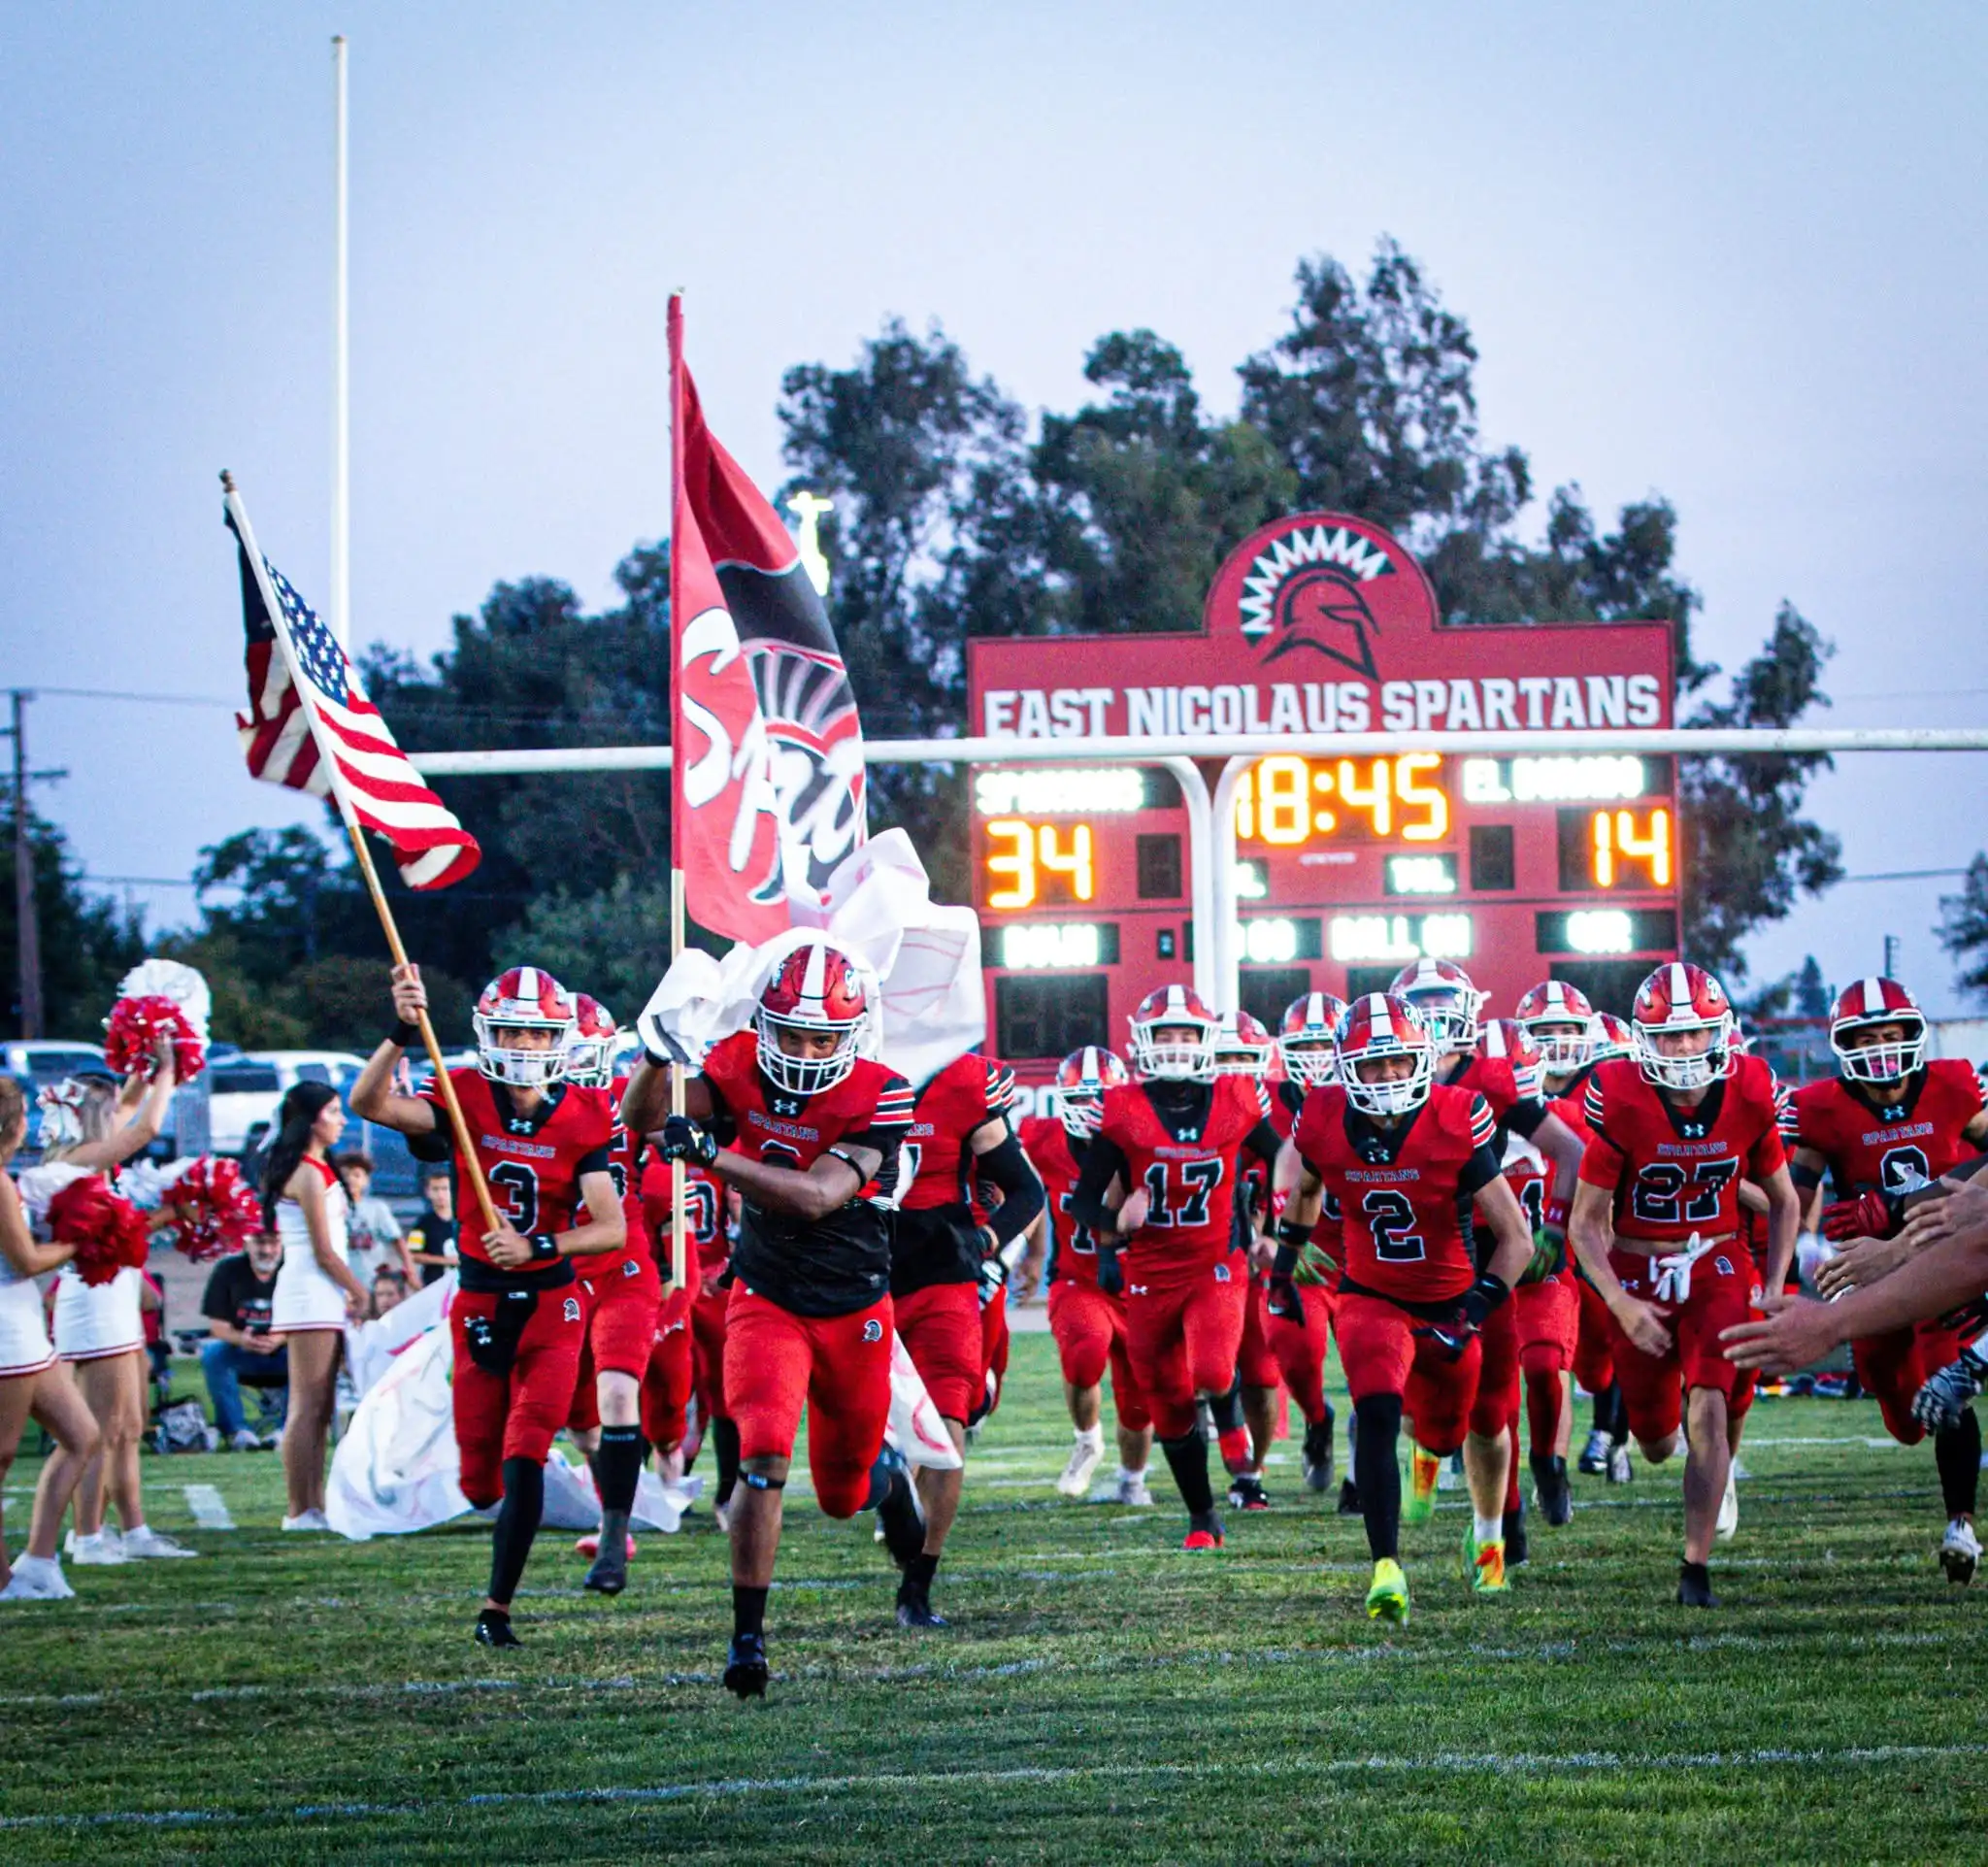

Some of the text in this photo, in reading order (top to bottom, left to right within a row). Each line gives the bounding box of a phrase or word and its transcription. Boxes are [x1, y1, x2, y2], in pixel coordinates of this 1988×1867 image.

[983, 674, 1660, 739] EAST NICOLAUS SPARTANS
[986, 819, 1093, 909] 34
[1594, 810, 1671, 887] 14
[488, 1159, 539, 1236] 3
[1144, 1156, 1224, 1228] 17
[1362, 1188, 1427, 1262] 2
[1633, 1154, 1740, 1223] 27
